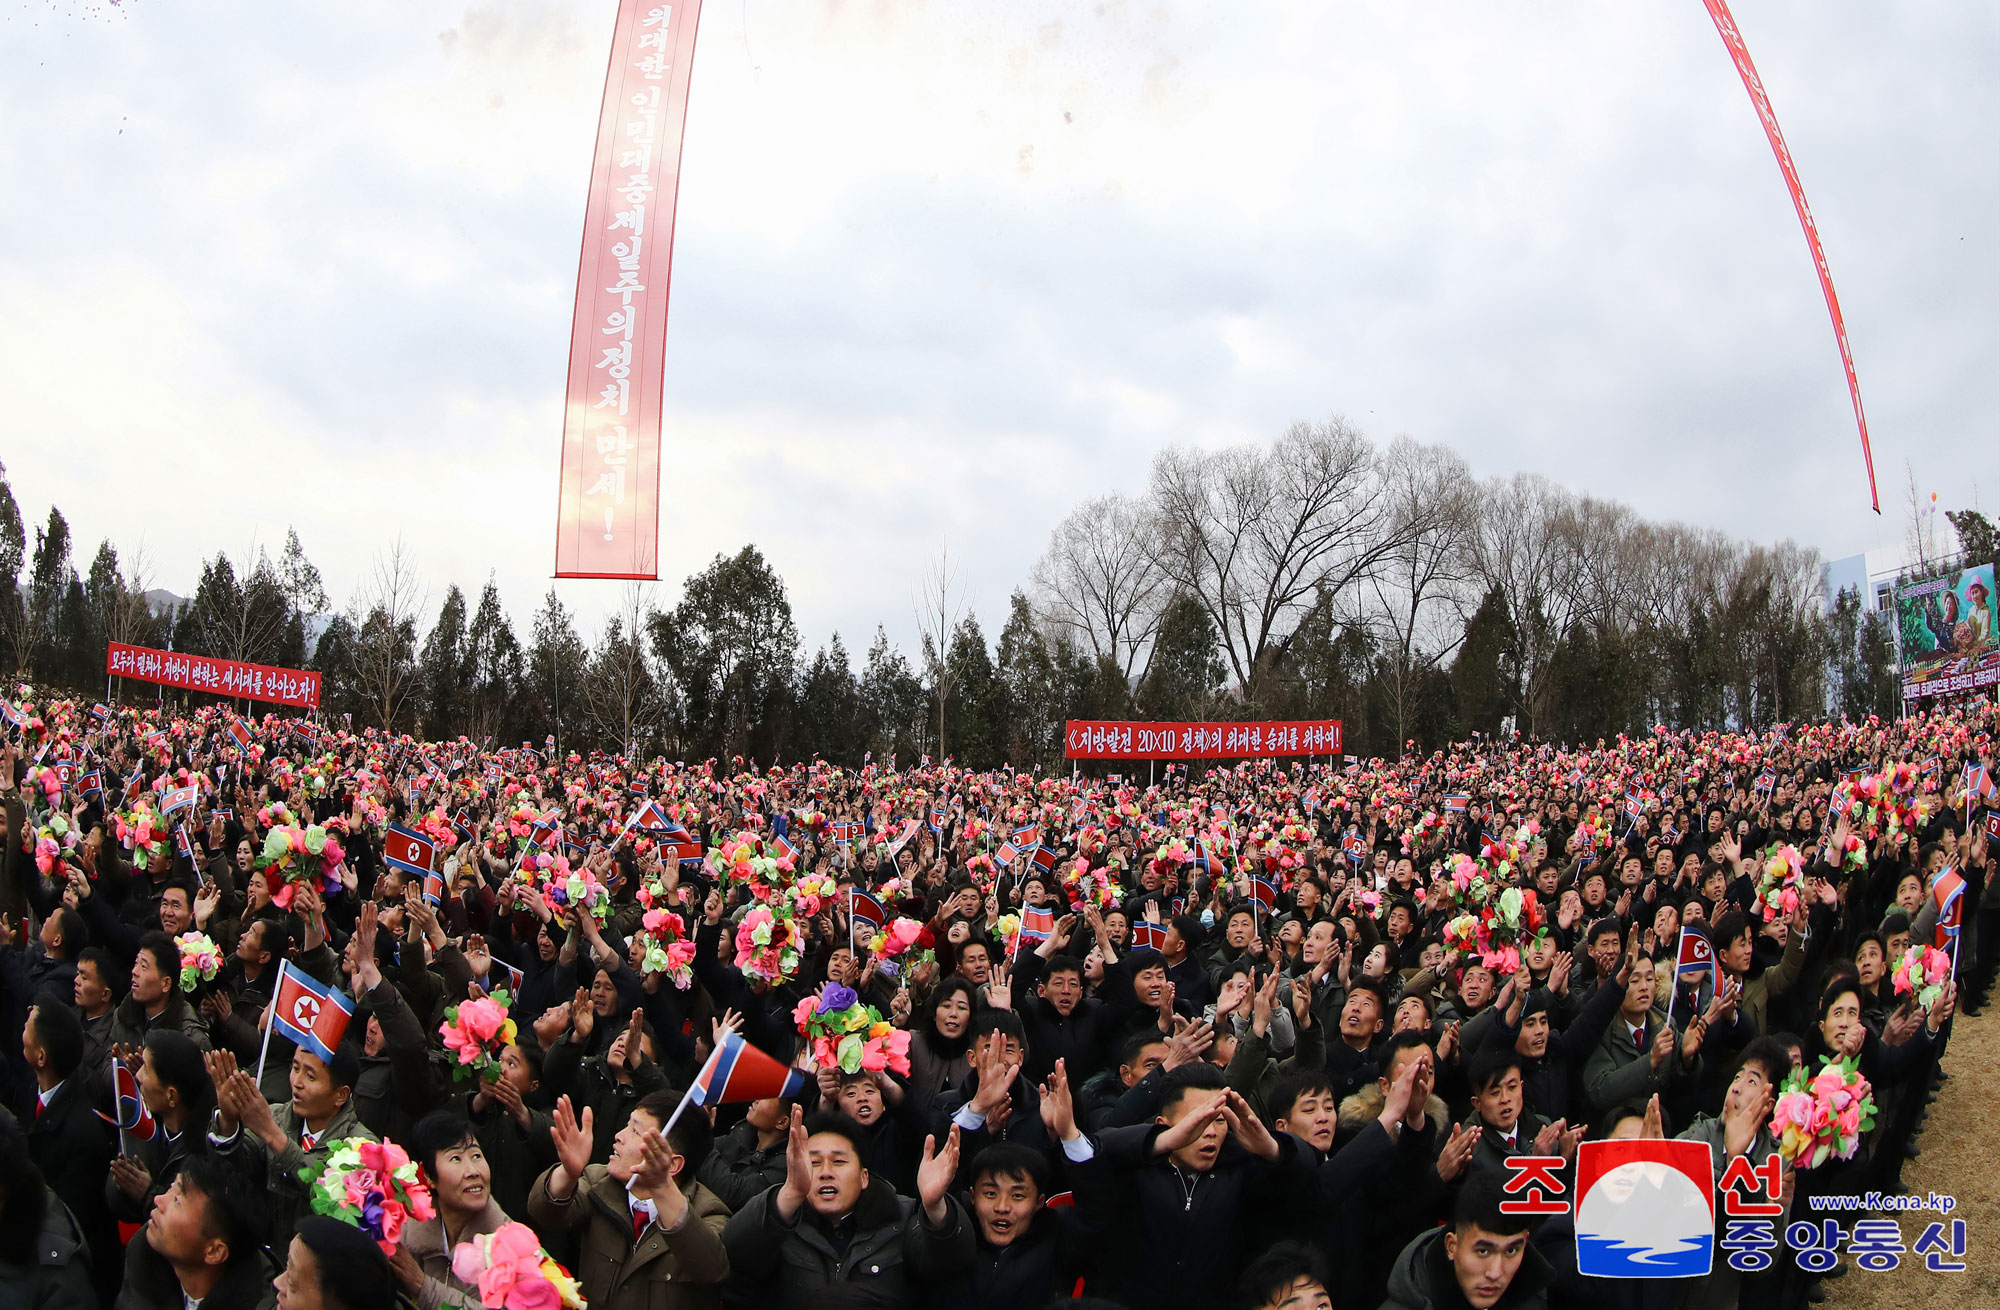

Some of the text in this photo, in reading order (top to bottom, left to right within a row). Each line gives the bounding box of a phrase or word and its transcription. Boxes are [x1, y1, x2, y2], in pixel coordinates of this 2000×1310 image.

[633, 4, 673, 79] 위대한
[585, 426, 634, 542] 만세!
[111, 650, 136, 674] 모두다
[163, 656, 190, 684] 지방이
[192, 661, 220, 688] 변하는
[221, 665, 264, 695] 새시대를
[266, 672, 316, 702] 안아오자!
[1226, 727, 1261, 752] 위대한
[1265, 726, 1299, 751] 승리를
[1303, 725, 1339, 750] 위하여!
